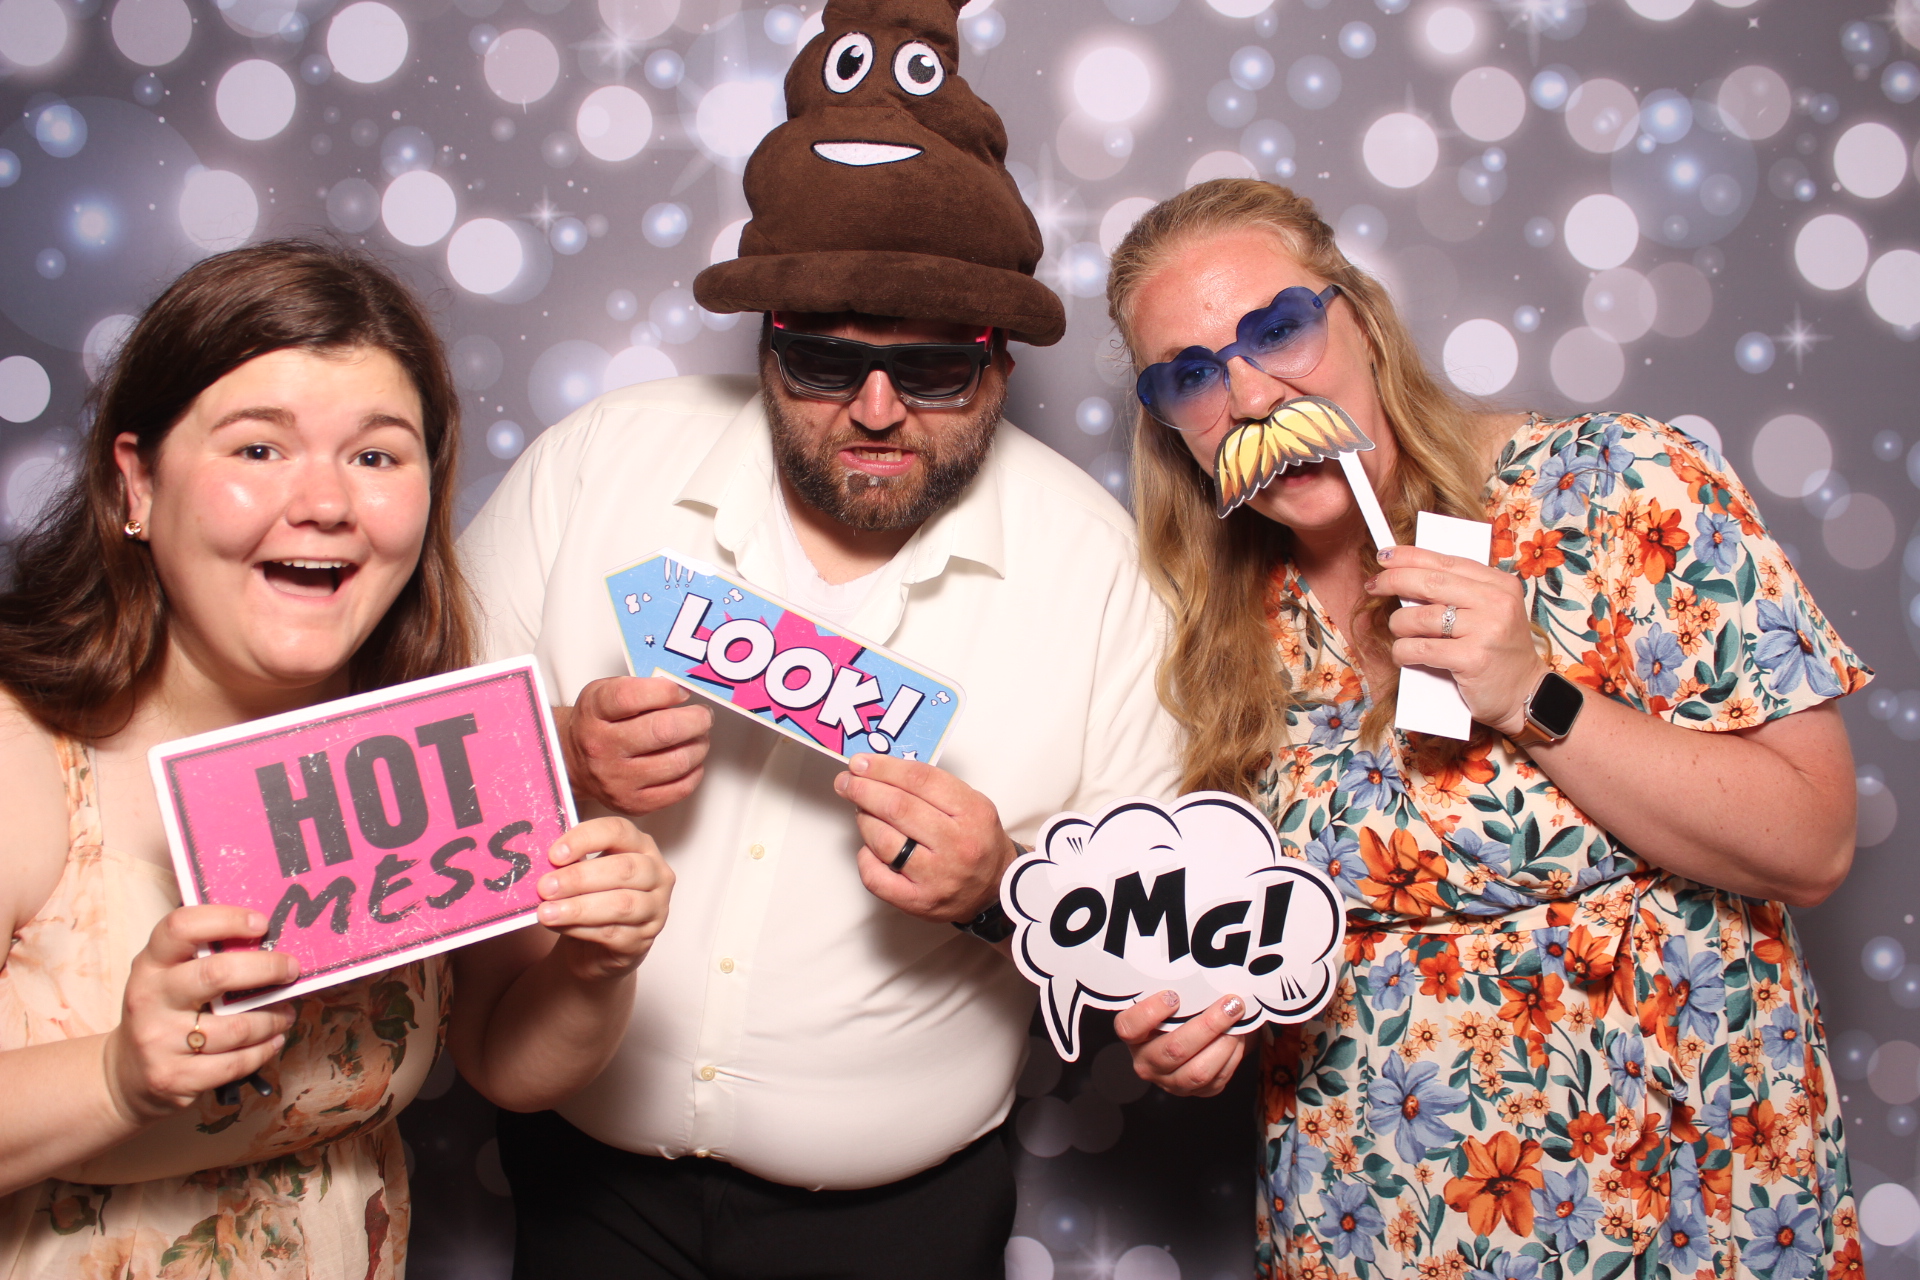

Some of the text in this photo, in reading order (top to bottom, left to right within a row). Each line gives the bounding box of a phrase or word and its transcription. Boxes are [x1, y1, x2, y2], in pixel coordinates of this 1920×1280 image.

[664, 592, 925, 754] LOOK!
[255, 713, 483, 878] HOT
[259, 820, 534, 951] MESS
[1049, 867, 1294, 976] OMG!
